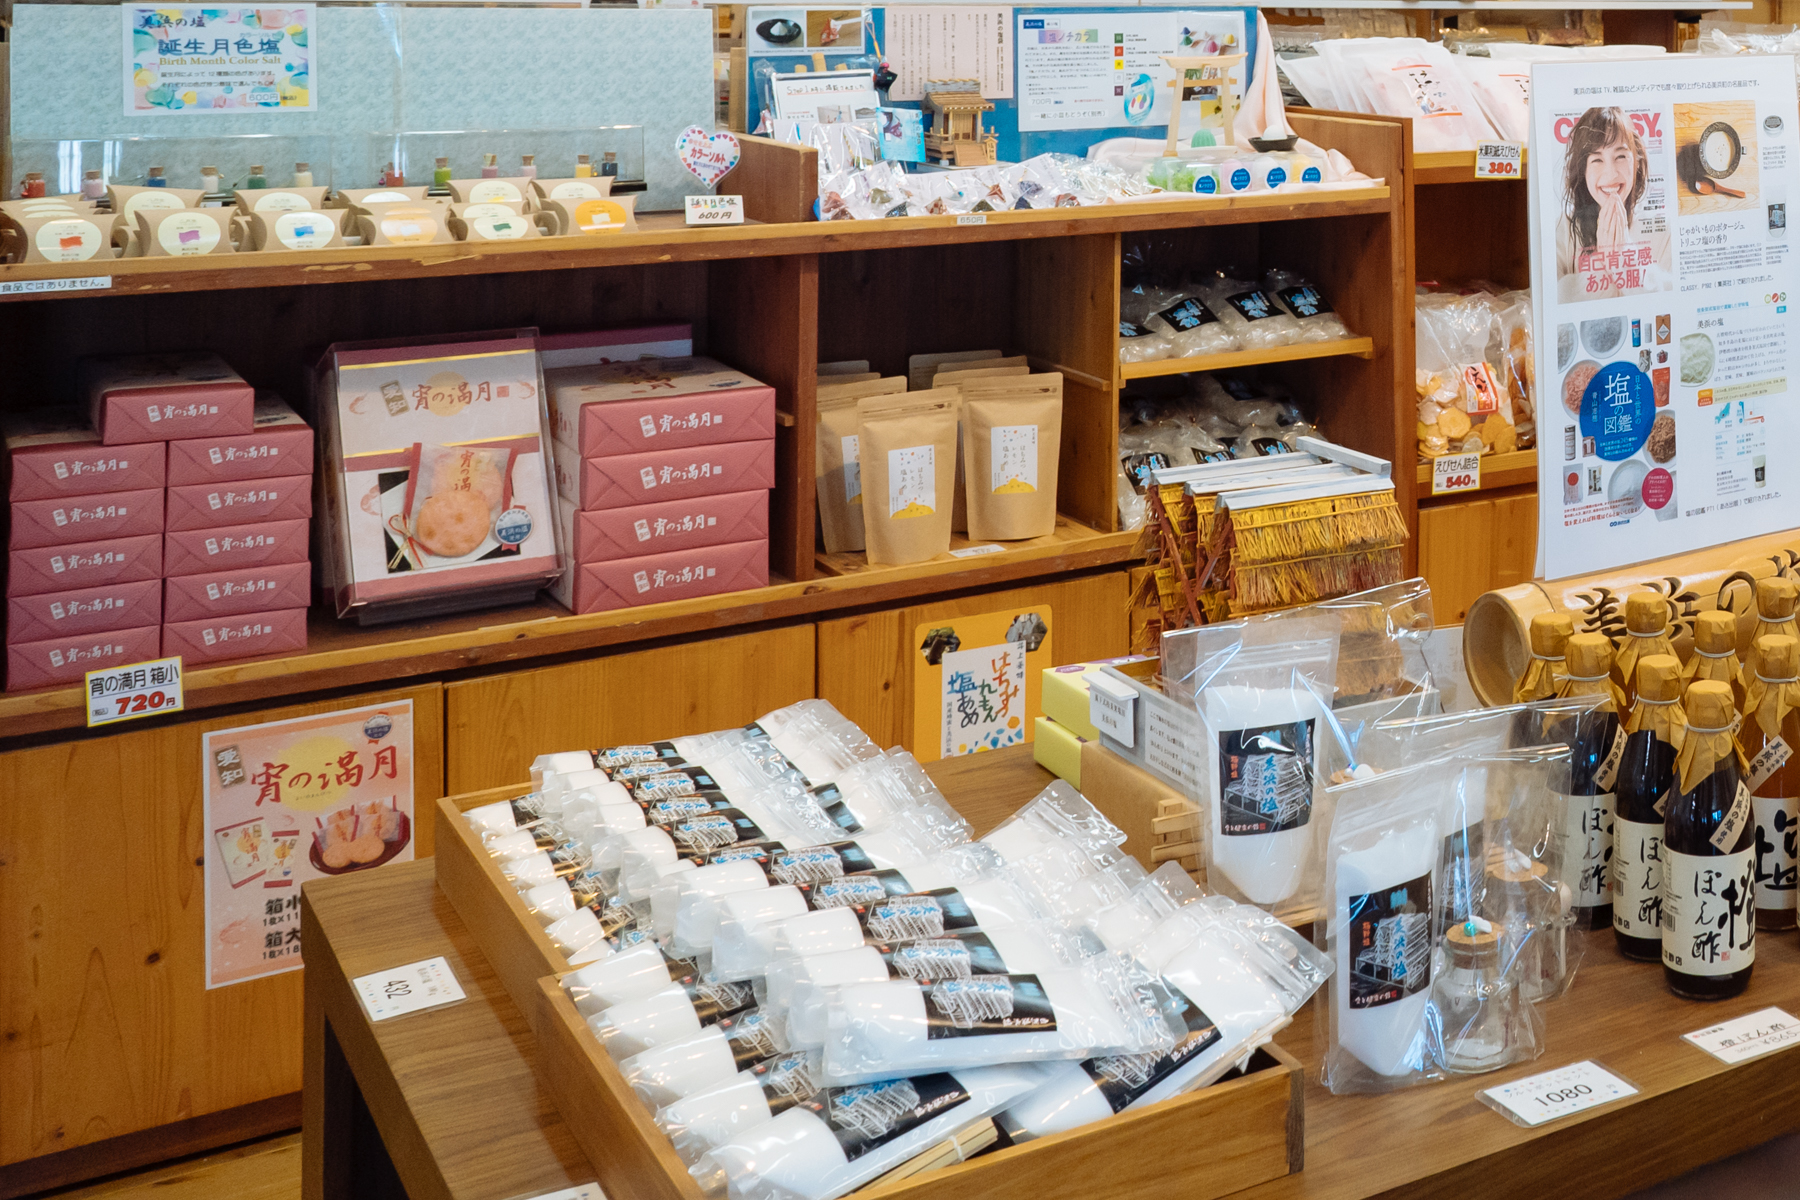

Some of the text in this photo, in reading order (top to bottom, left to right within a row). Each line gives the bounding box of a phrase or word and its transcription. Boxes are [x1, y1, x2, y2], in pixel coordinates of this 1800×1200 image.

[1048, 31, 1091, 42] 塩ノチカラ
[158, 38, 282, 56] 誕生月色塩
[160, 56, 281, 65] Birth Month Color Salt
[690, 147, 726, 165] カラーソルト
[1488, 162, 1517, 174] 380円
[1679, 221, 1745, 236] じゃがいものポタージュ
[1680, 235, 1728, 248] トリュフ塩の香り
[1, 277, 105, 293] 食品ではありません。
[1697, 318, 1724, 329] 美浜の塩
[411, 381, 492, 411] 宵の満月
[659, 412, 712, 434] 宵の満月
[659, 463, 711, 485] 宵の満月
[1435, 455, 1480, 474] えびせん詰合
[1446, 474, 1476, 488] 540円
[653, 514, 705, 536] 宵の満月
[653, 566, 705, 588] 宵の満月
[90, 664, 179, 696] 宵の満月 箱小
[115, 691, 176, 714] 720円
[251, 745, 398, 807] 宵の満月
[1261, 755, 1279, 814] 美浜の塩
[1692, 869, 1722, 963] ぽん酢
[1532, 1083, 1594, 1107] 1080
